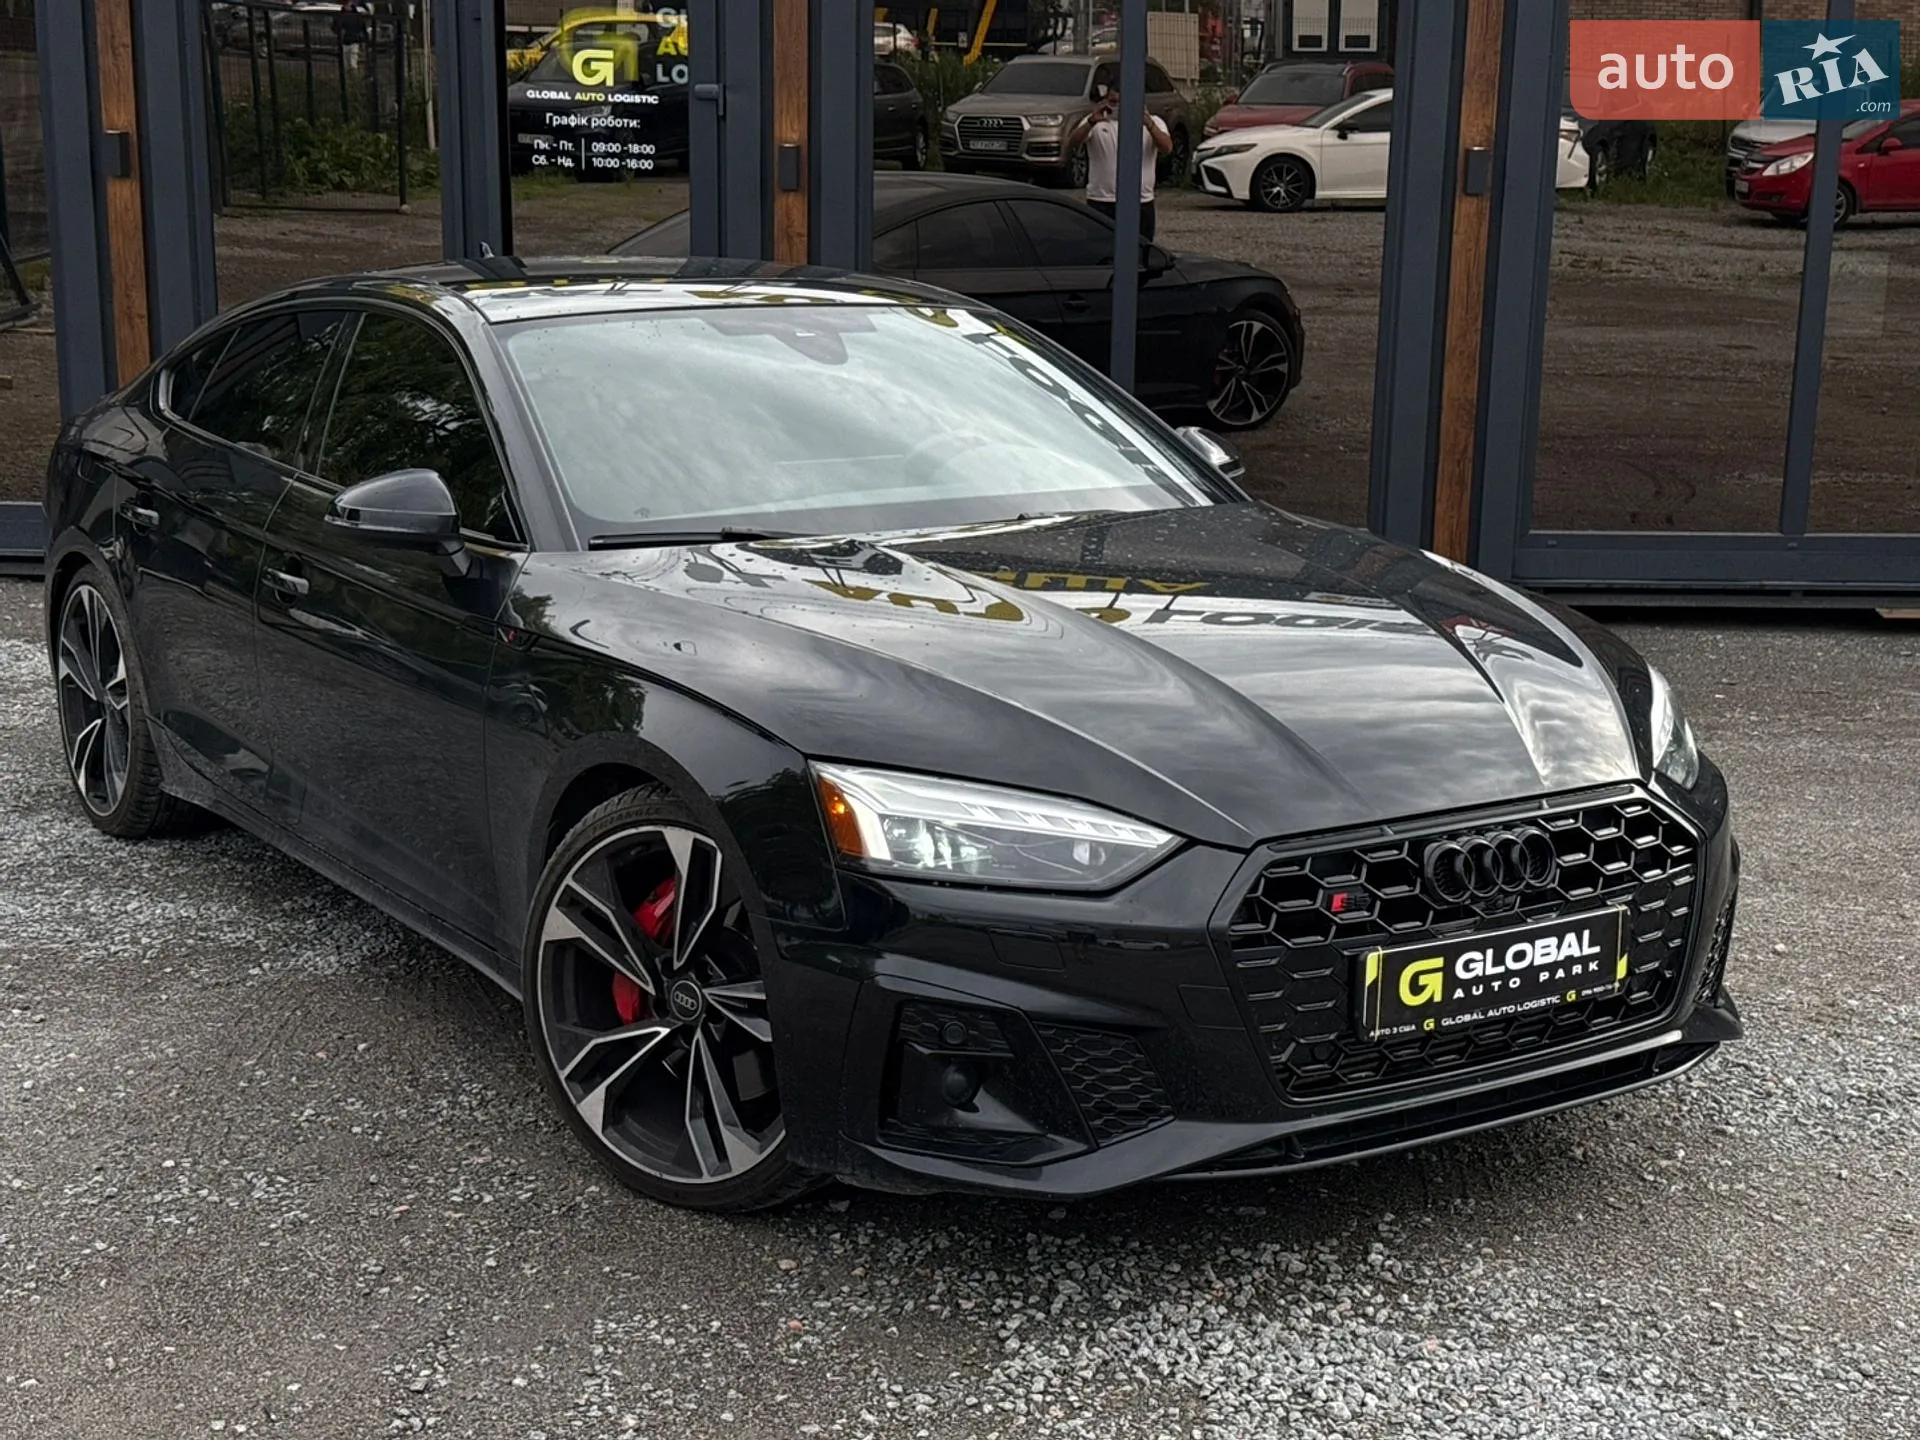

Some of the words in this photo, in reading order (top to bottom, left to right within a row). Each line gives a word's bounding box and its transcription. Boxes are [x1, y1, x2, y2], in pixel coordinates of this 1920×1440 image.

[526, 89, 571, 100] GLOBAL
[574, 91, 605, 102] AUTO
[608, 93, 660, 104] LOGISTIC
[545, 113, 588, 127] Графік
[591, 114, 640, 128] роботи:
[591, 142, 621, 153] 09:00
[592, 157, 620, 168] 10:00
[1454, 929, 1601, 980] GLOBAL
[1452, 976, 1521, 999] AUTO
[1539, 960, 1599, 983] PARK
[1441, 1013, 1485, 1026] GLOBAL
[1487, 1005, 1516, 1018] AUTO
[1517, 995, 1561, 1012] LOGISTIC
